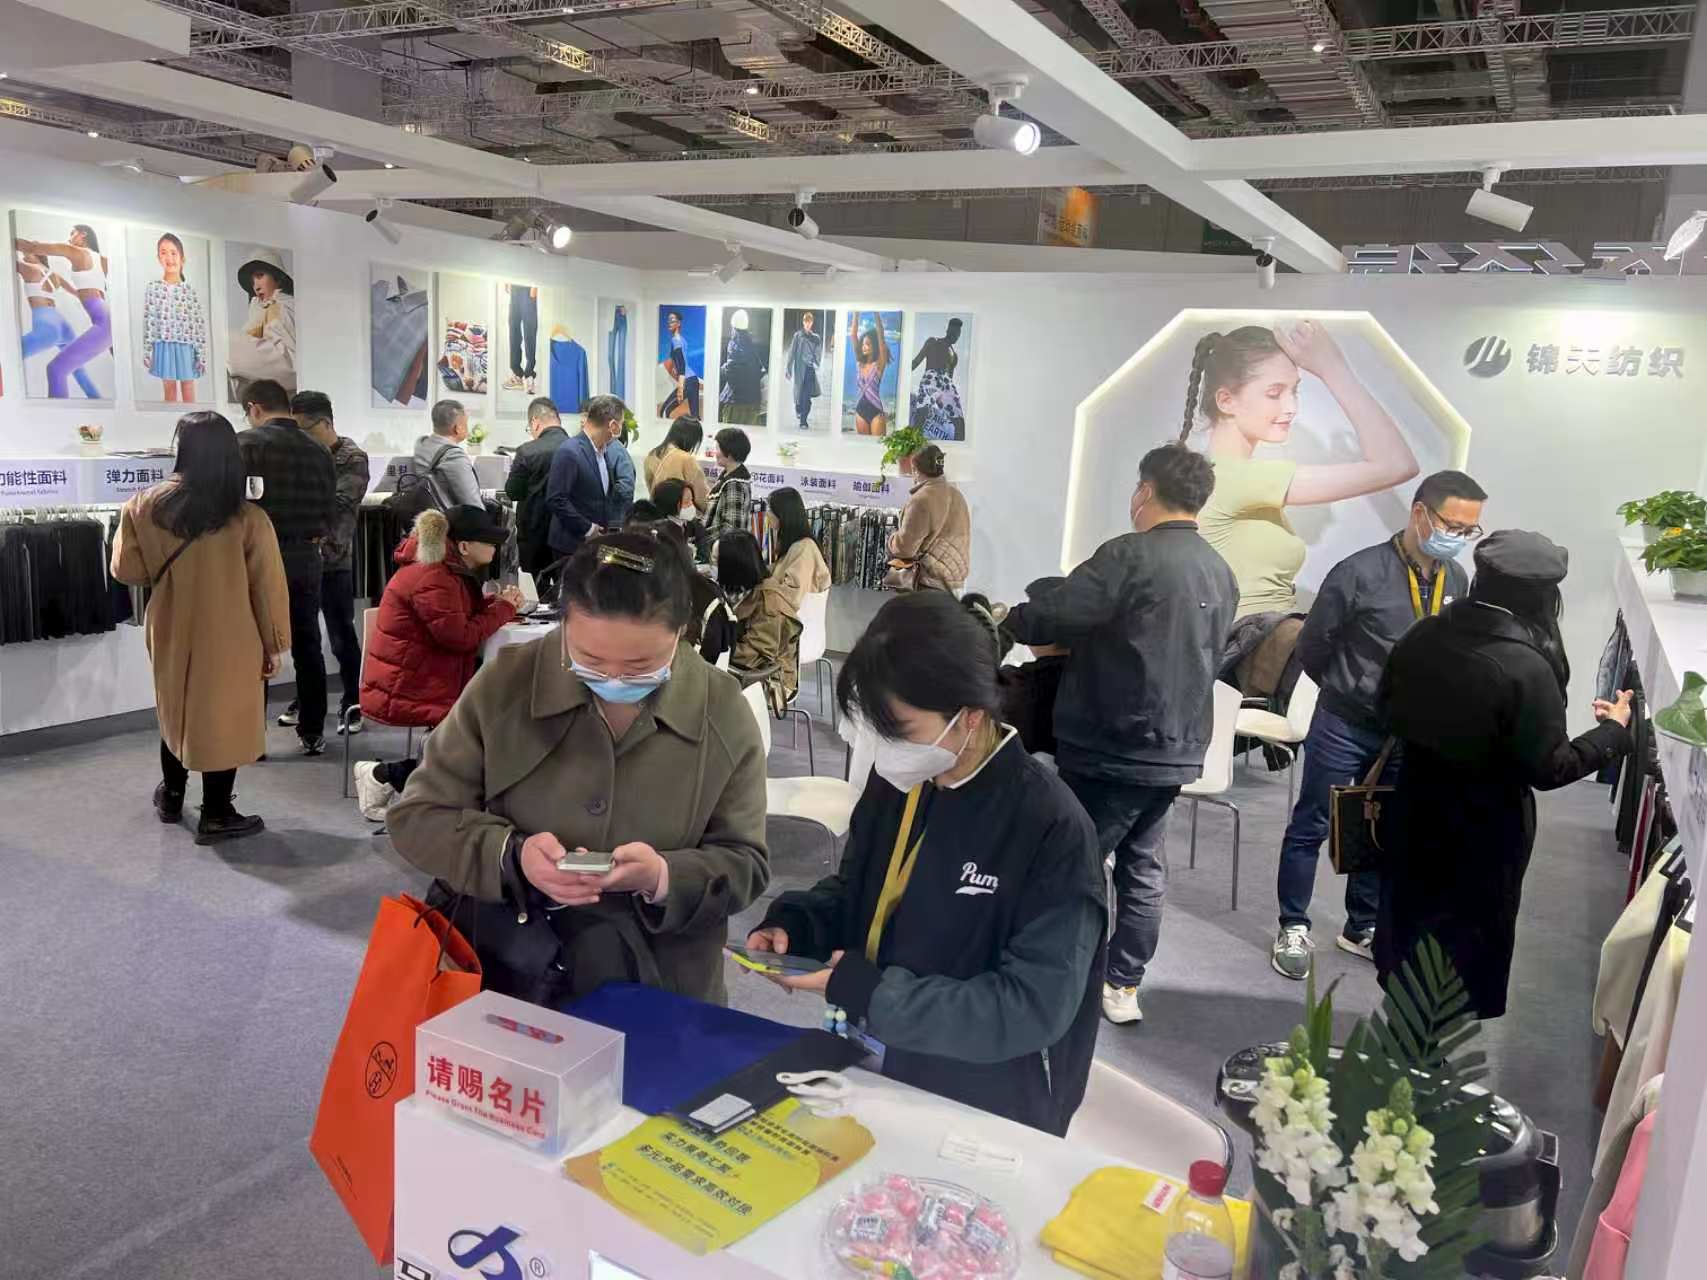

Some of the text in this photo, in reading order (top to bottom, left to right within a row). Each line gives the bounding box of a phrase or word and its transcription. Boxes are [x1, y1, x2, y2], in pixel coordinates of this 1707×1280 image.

[1526, 343, 1686, 378] 锦天纺织
[106, 469, 164, 484] 弹力面料
[426, 1055, 545, 1124] 请赐名片
